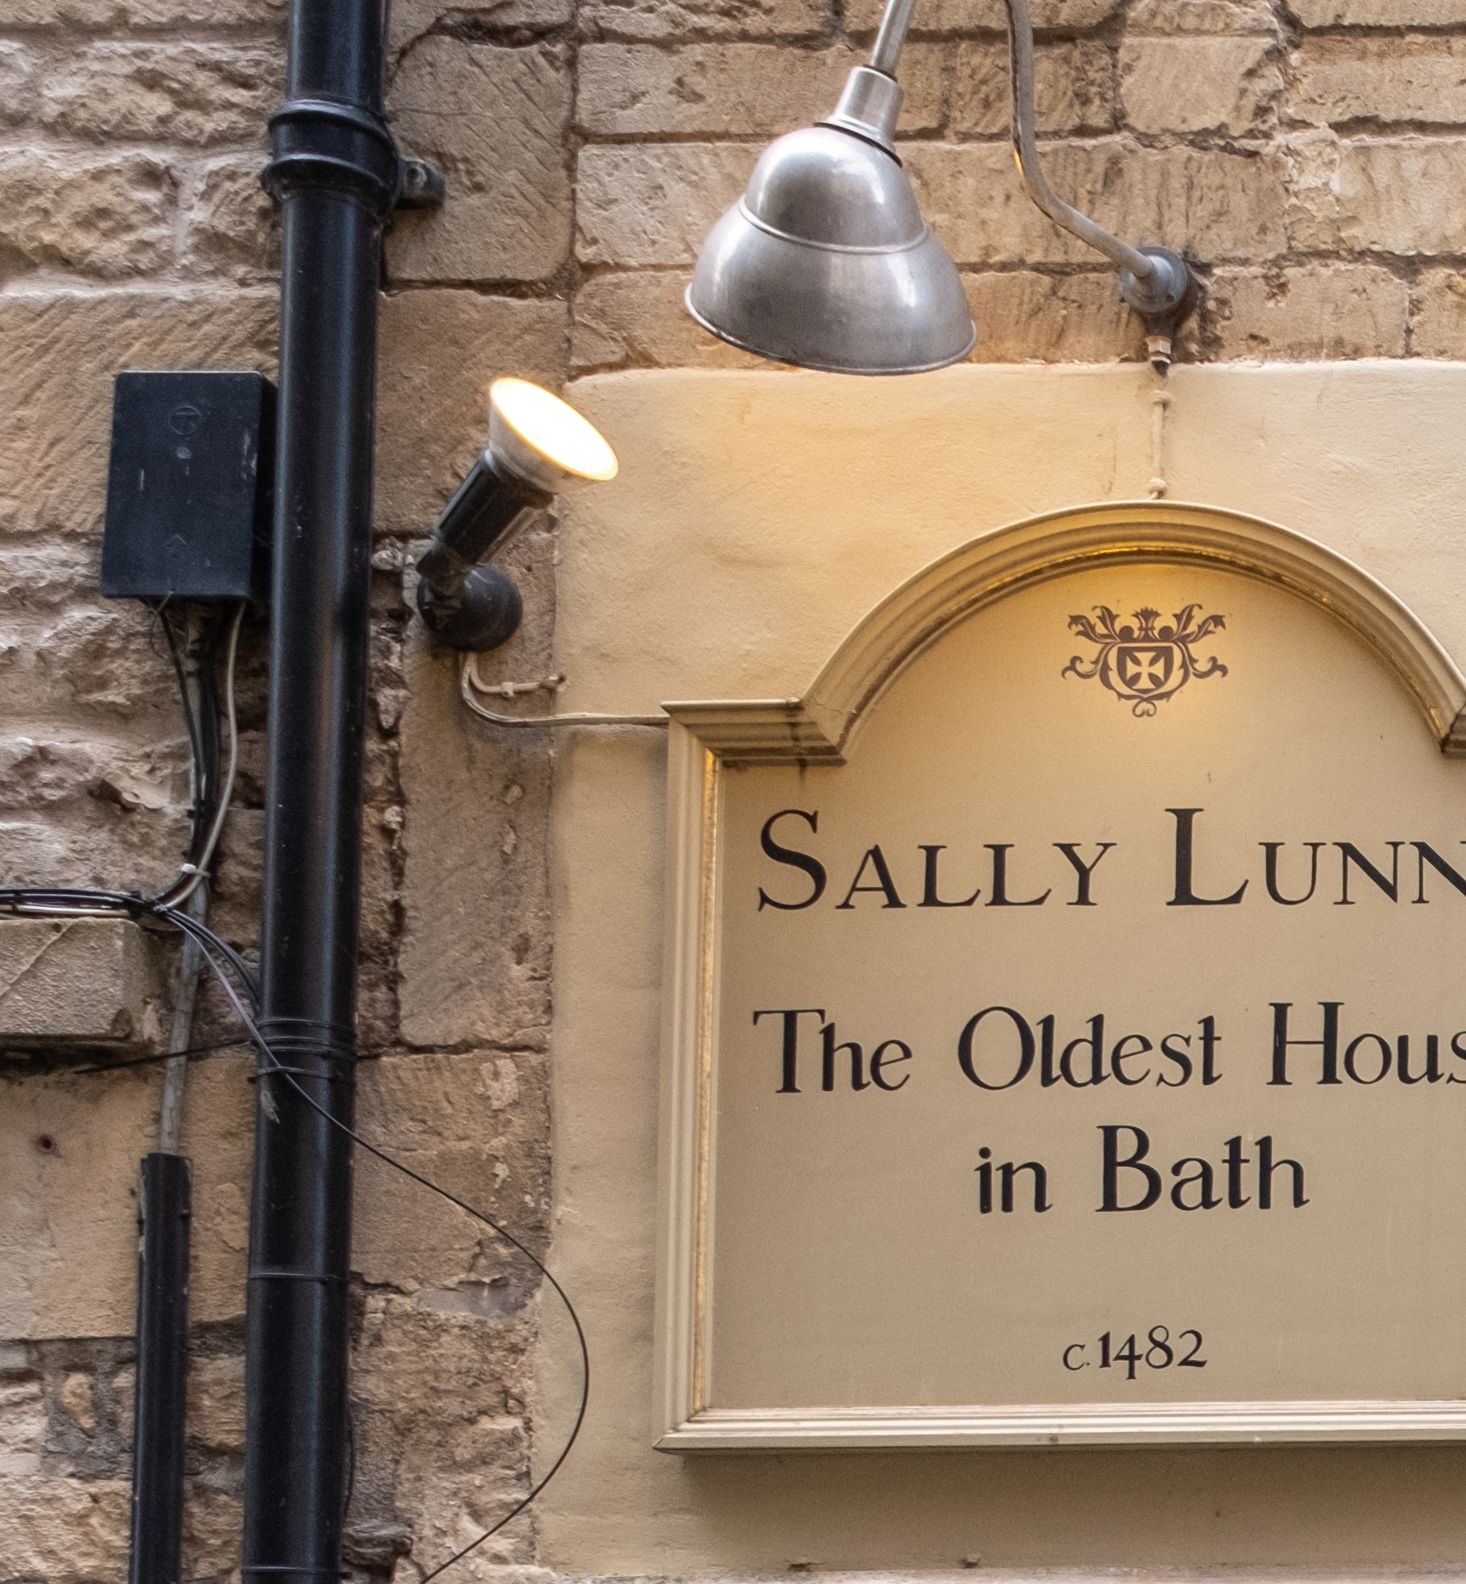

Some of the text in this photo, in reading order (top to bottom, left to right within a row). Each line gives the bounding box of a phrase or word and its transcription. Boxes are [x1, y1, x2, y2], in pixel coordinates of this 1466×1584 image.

[757, 808, 1117, 912] SALLY
[752, 1008, 913, 1095] The
[957, 1005, 1224, 1091] Oldest
[973, 1124, 1310, 1215] in Bath
